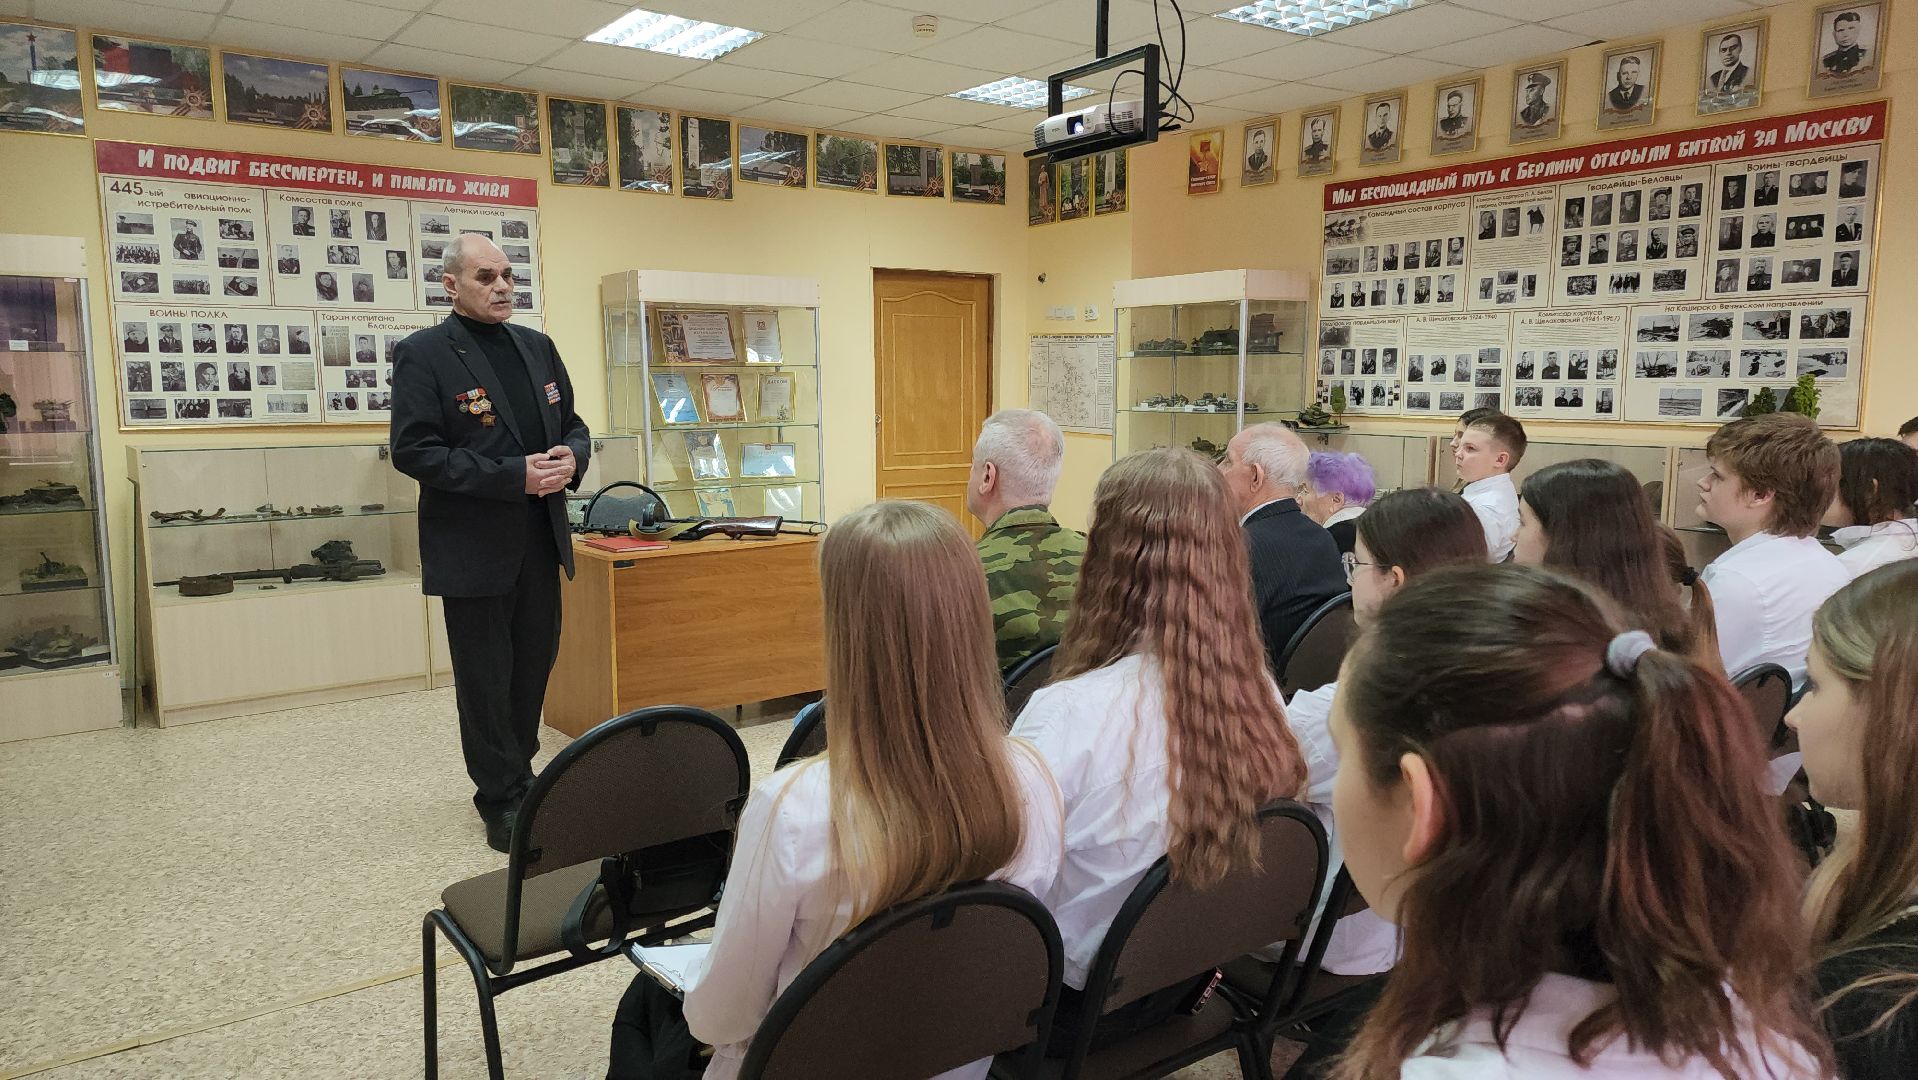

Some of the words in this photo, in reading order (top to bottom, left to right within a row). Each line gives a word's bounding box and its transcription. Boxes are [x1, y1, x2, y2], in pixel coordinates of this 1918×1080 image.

[109, 180, 164, 197] 445-ый
[1587, 173, 1684, 192] Гвардейцы-Беловцы
[137, 199, 226, 213] истребительный
[228, 206, 252, 214] полк
[279, 192, 333, 206] Комсостав
[335, 199, 363, 208] полка
[1408, 205, 1433, 215] состав
[1433, 200, 1466, 212] корпуса
[1766, 300, 1823, 309] направлении
[149, 309, 188, 319] ВОИНЫ
[191, 310, 229, 319] ПОЛКА
[321, 313, 350, 324] Таран
[351, 314, 395, 323] капитана
